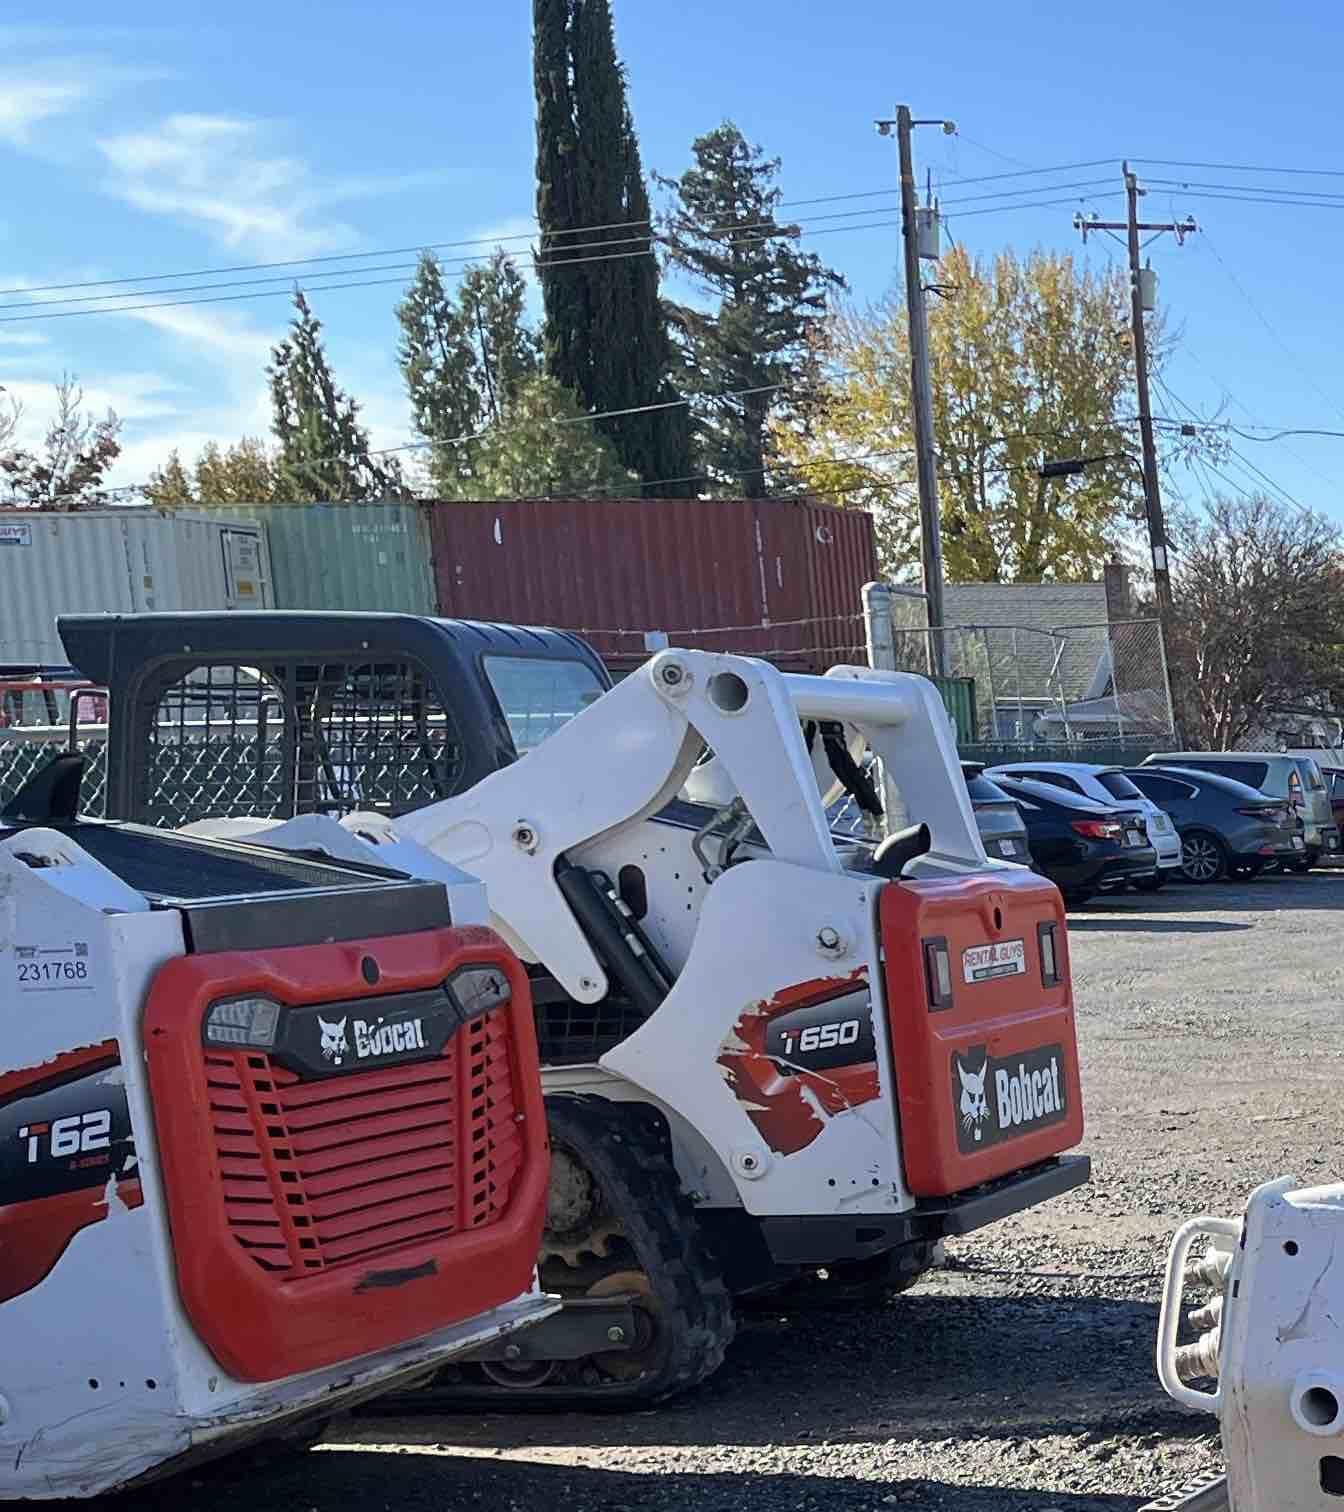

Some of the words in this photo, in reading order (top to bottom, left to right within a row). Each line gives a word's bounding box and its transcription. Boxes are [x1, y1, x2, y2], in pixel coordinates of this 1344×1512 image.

[17, 961, 88, 981] 231768
[780, 1020, 859, 1055] T650
[995, 1056, 1061, 1129] Bobcat
[18, 1109, 112, 1163] T62
